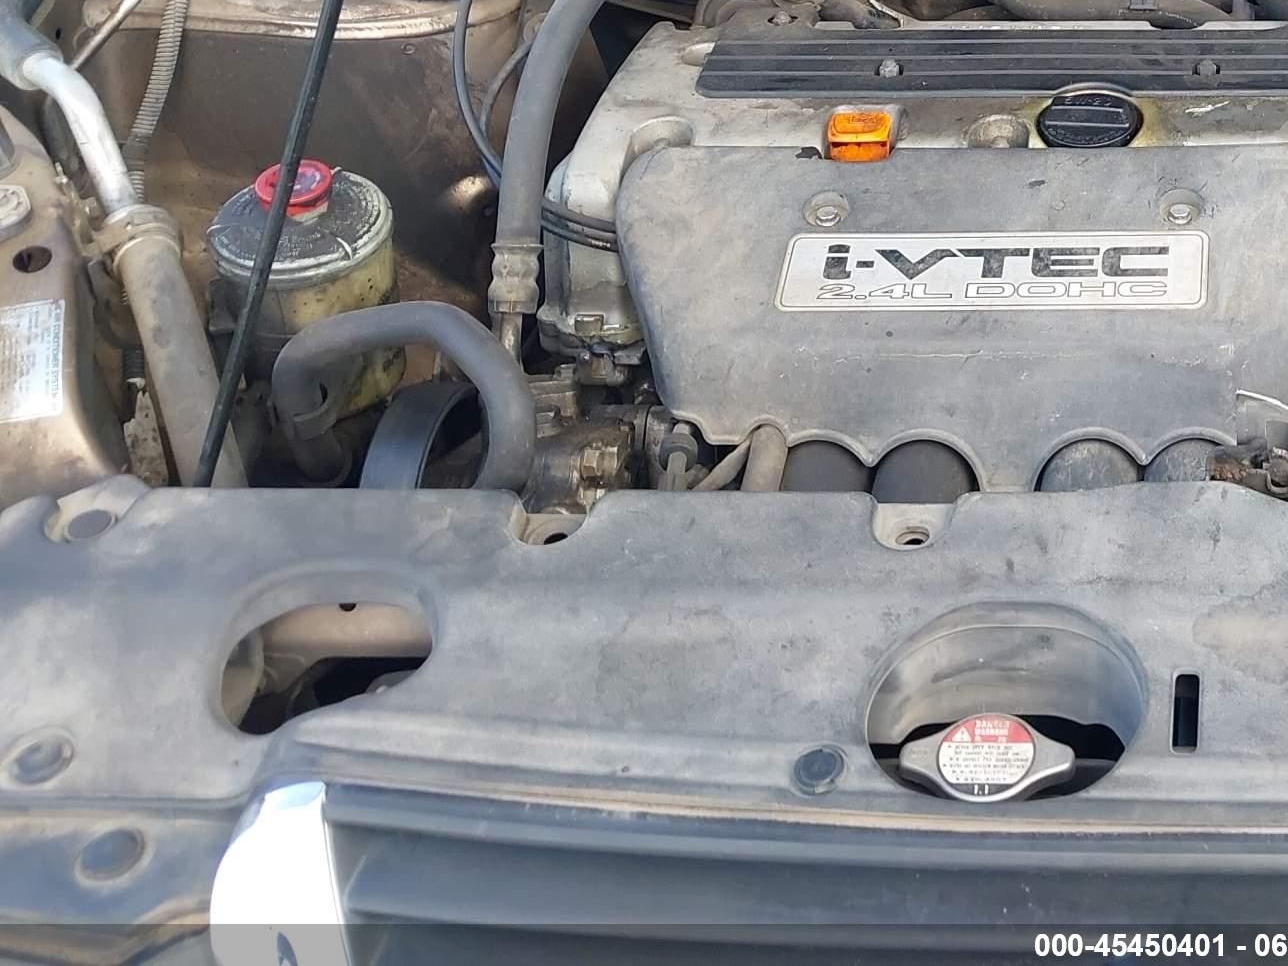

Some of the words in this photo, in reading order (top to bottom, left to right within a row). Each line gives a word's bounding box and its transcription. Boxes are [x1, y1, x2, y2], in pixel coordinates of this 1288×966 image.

[822, 243, 1170, 280] i-VTEC
[815, 282, 954, 300] 2.4L
[964, 281, 1168, 299] DOHC
